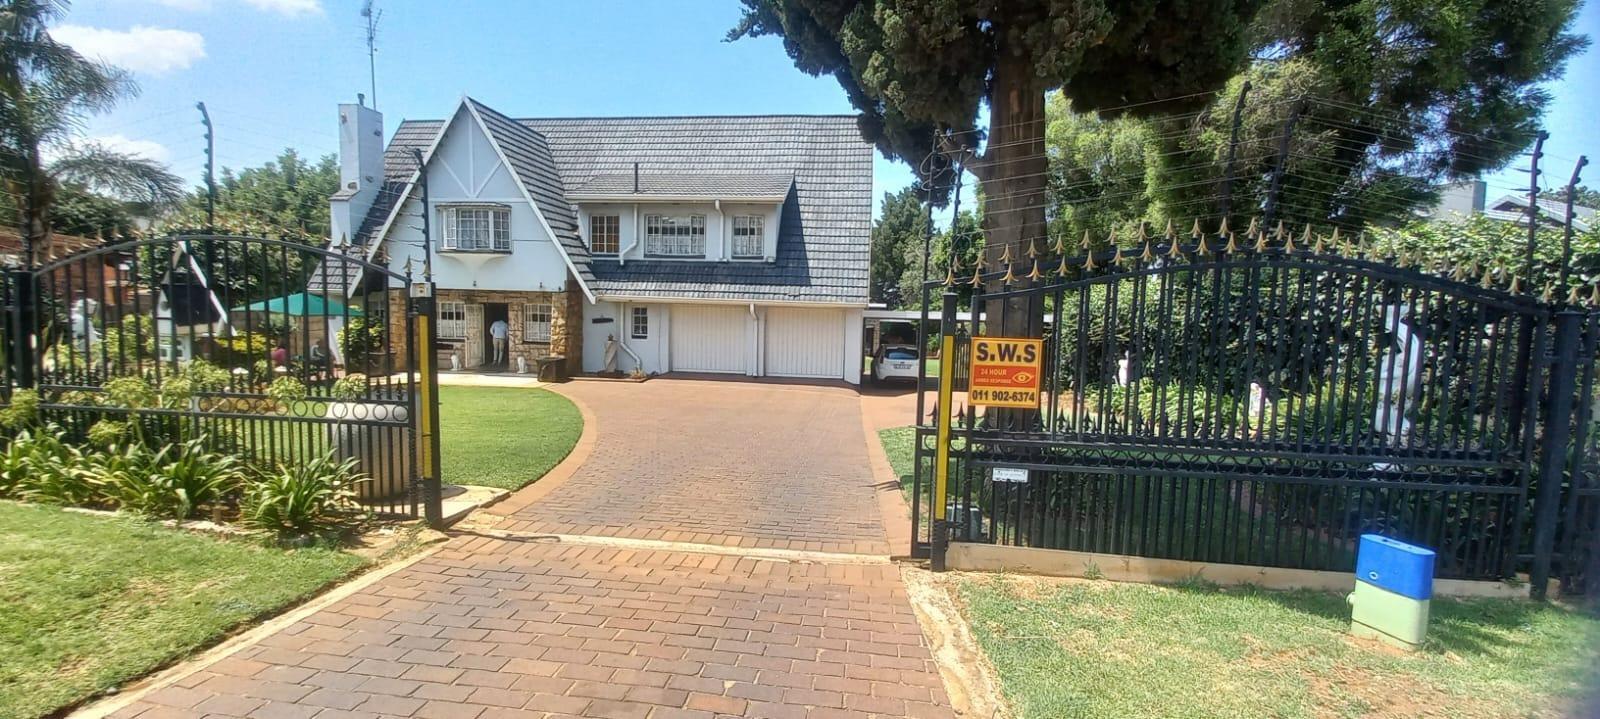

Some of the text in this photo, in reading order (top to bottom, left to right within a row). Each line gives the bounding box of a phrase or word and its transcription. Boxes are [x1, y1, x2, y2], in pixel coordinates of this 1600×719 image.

[976, 342, 1036, 363] S.W.S
[980, 368, 1007, 376] 24 HOUR
[972, 390, 1035, 402] 011 902-6374
